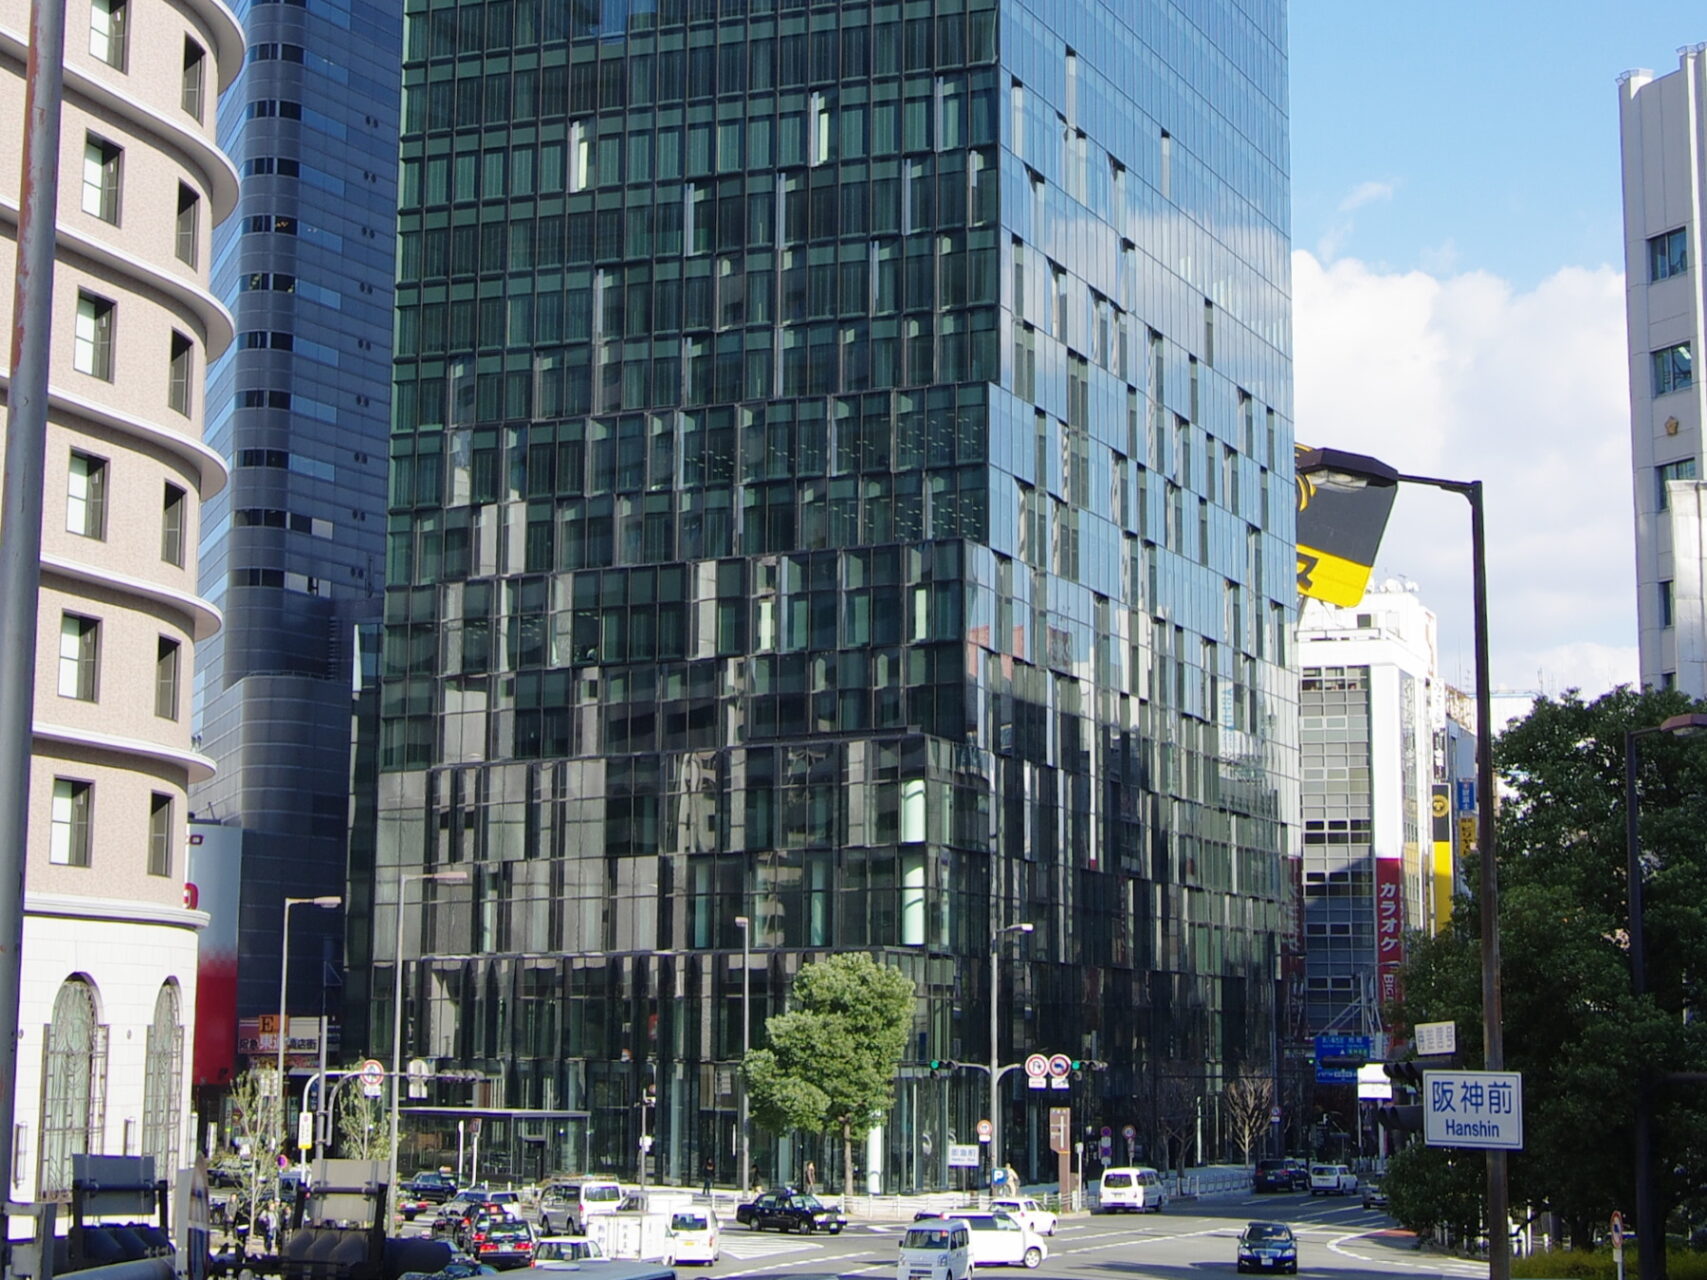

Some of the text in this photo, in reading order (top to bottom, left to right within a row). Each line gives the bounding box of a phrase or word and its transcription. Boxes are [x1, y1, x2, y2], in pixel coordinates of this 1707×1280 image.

[1380, 882, 1398, 952] カラオケ
[1432, 1080, 1512, 1114] 阪神前
[1445, 1119, 1500, 1138] Hanshin
